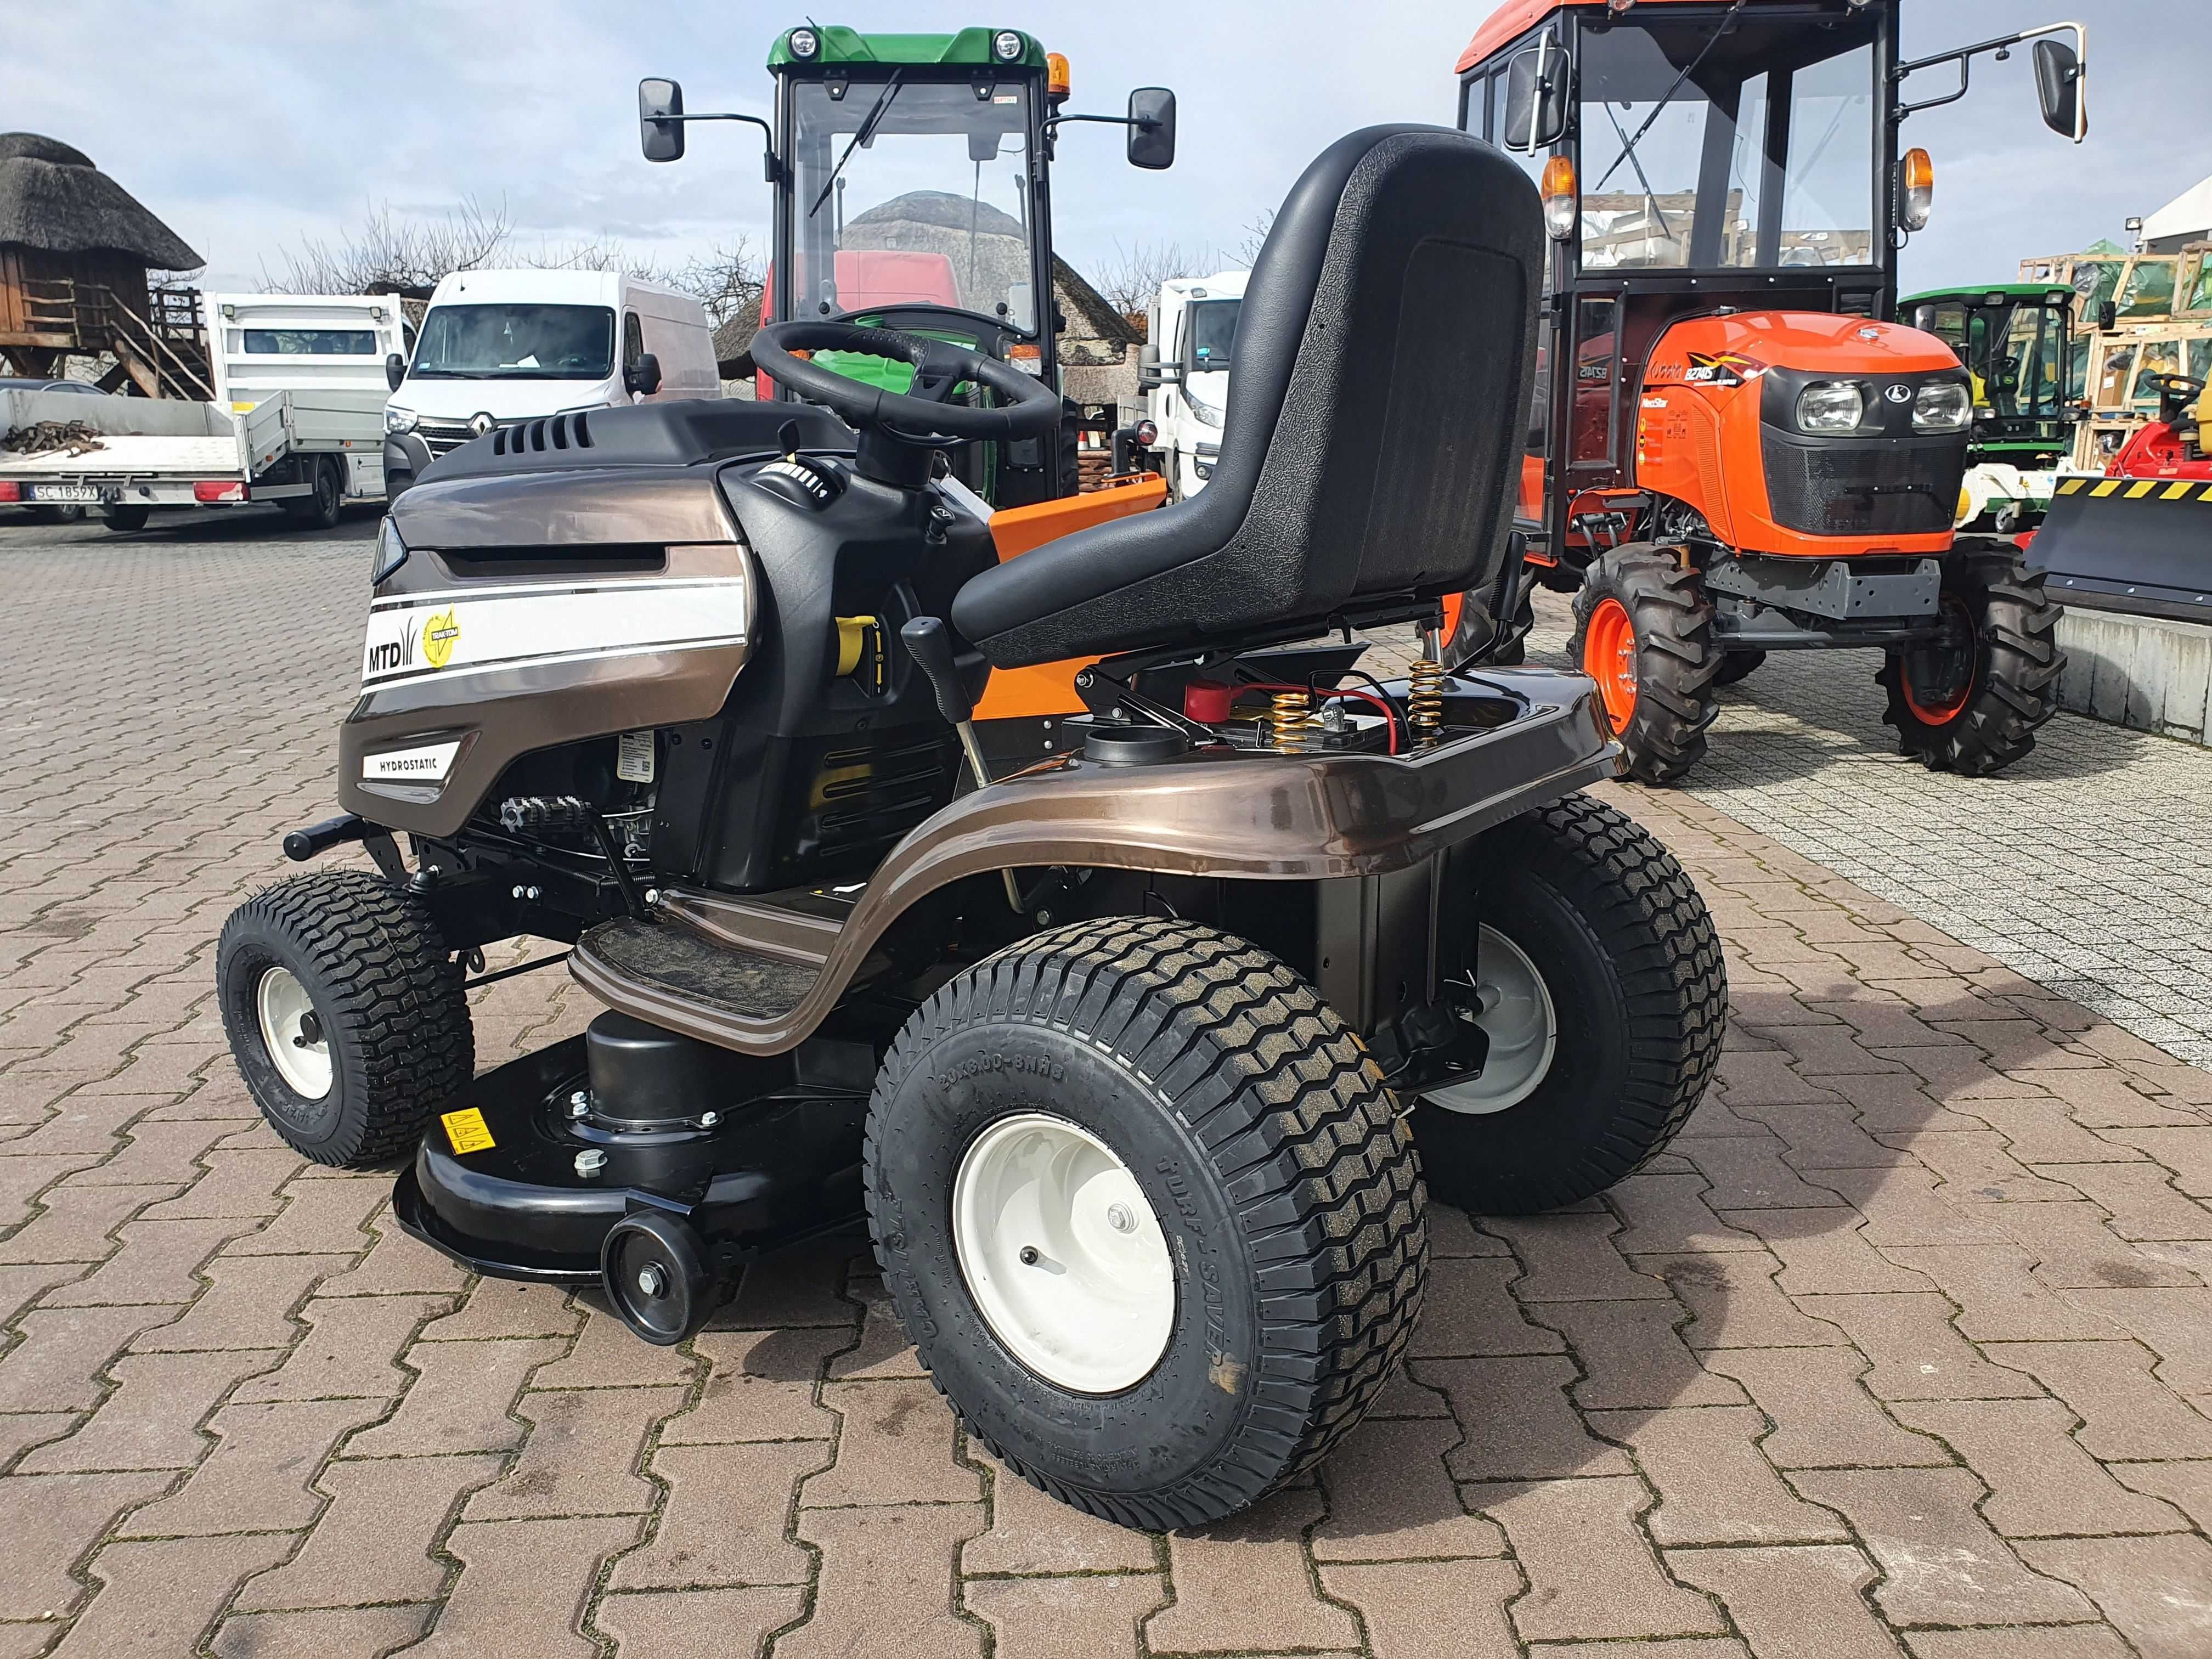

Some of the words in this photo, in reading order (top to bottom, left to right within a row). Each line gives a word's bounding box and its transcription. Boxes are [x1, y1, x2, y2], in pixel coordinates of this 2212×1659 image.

[37, 486, 53, 498] SC
[59, 486, 95, 498] 1859X
[369, 642, 401, 673] MTD
[380, 758, 437, 772] HYDROSTATIC
